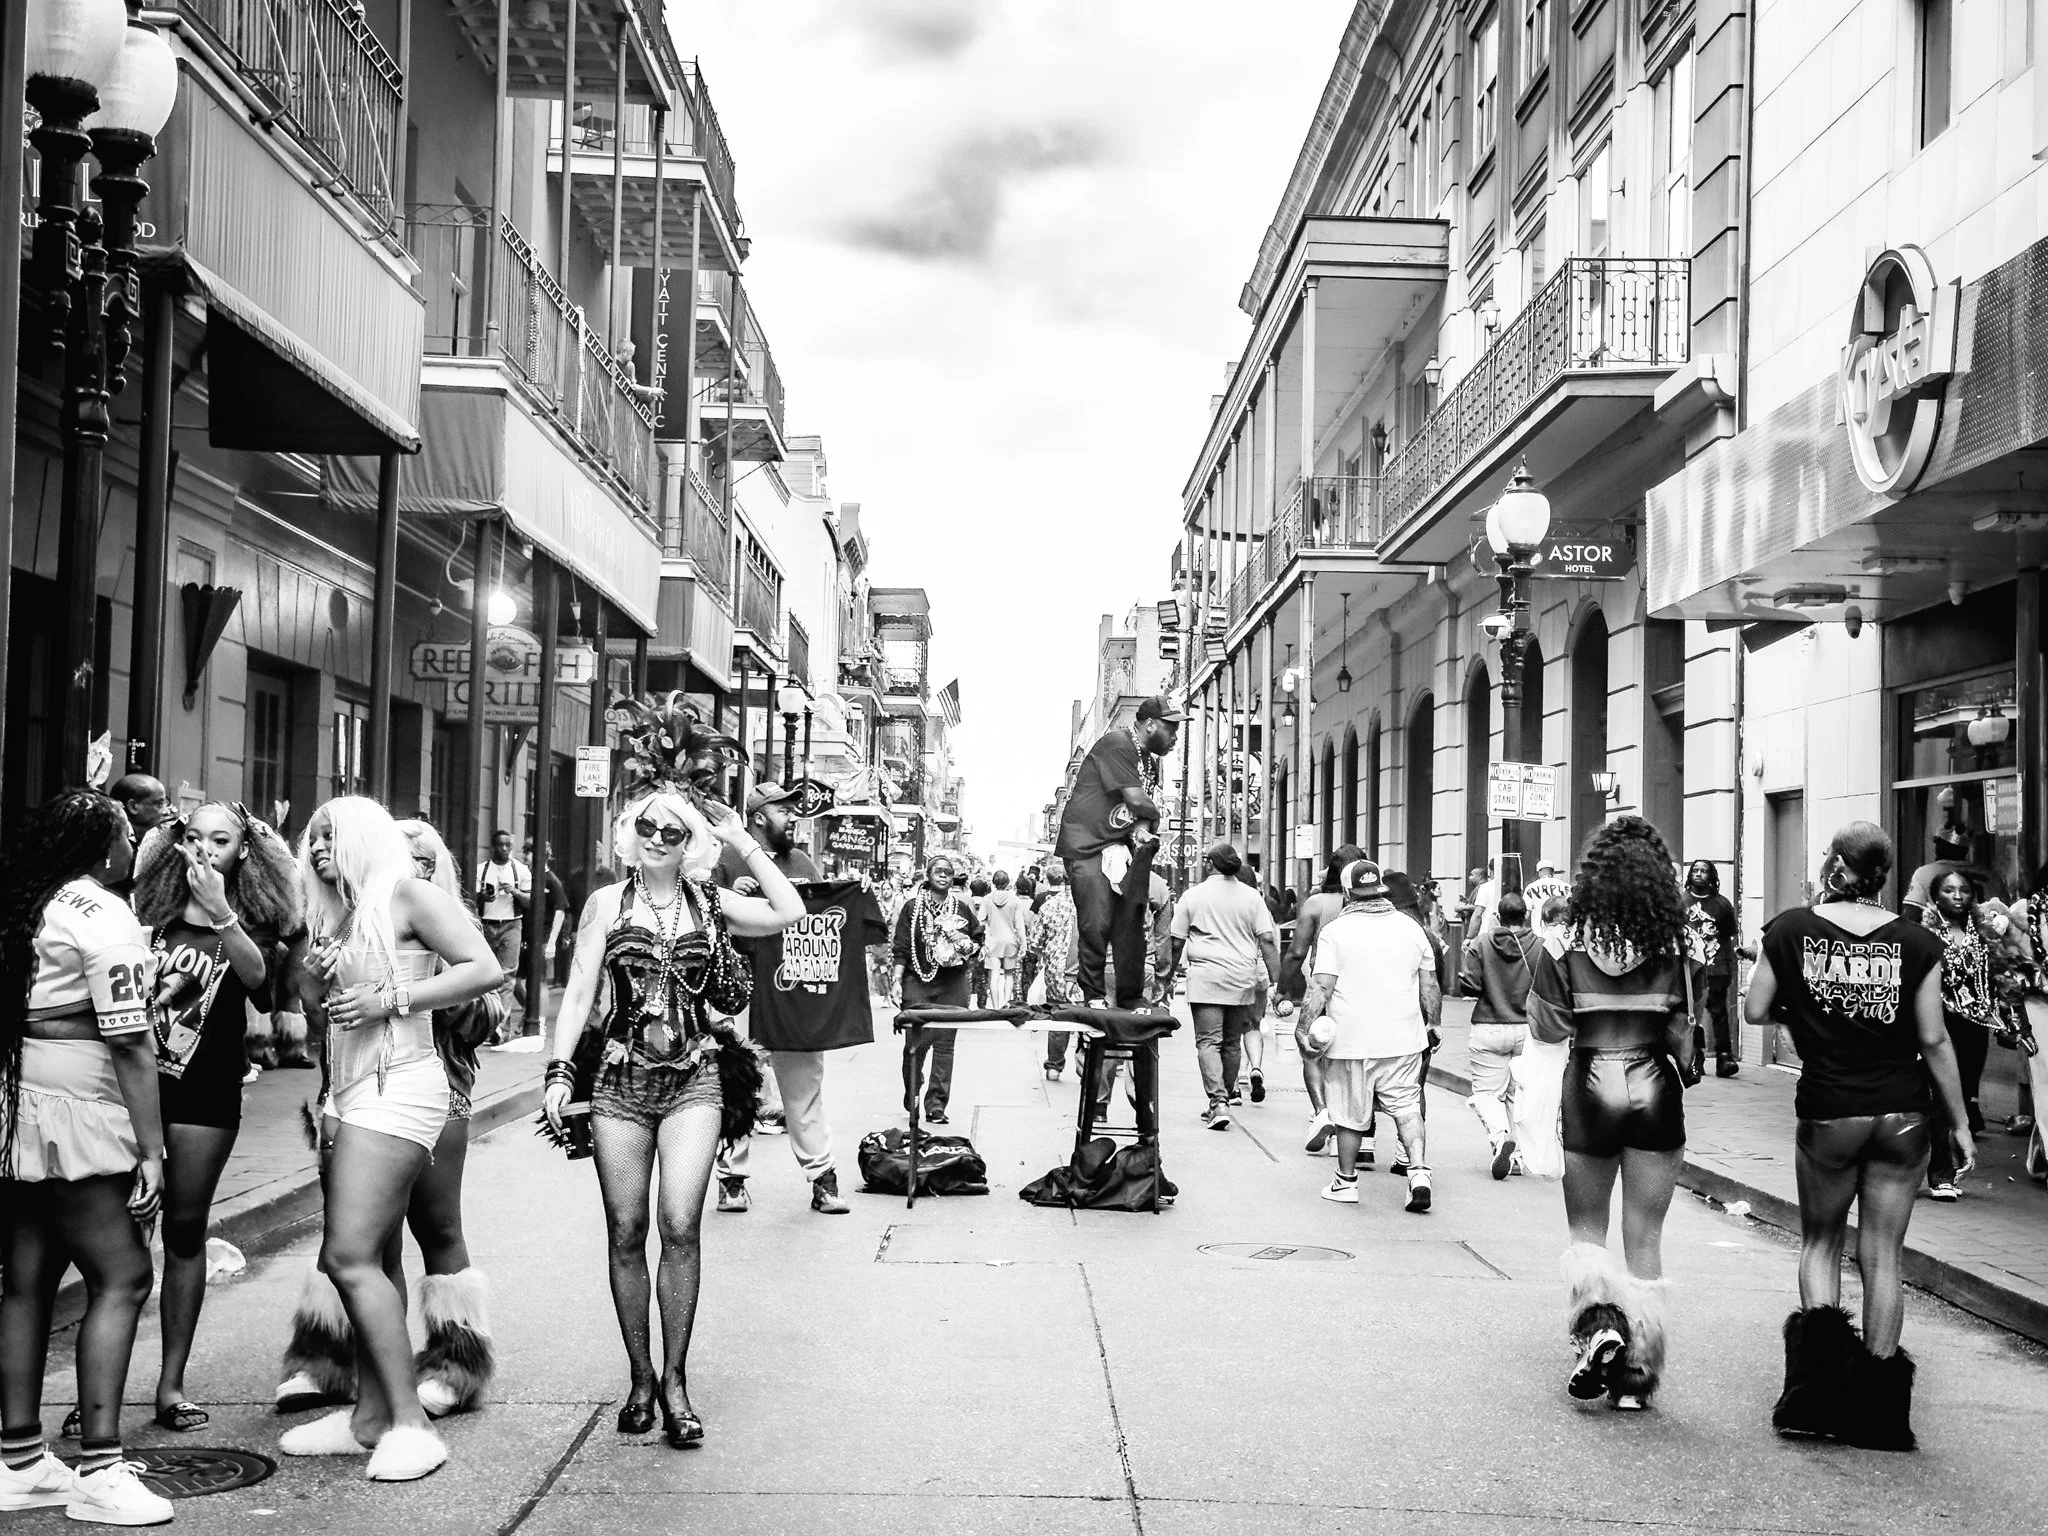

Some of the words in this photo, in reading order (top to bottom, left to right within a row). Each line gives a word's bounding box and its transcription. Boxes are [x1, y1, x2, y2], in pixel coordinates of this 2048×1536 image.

[1548, 545, 1613, 562] ASTOR
[1565, 564, 1596, 573] HOTEL
[523, 652, 581, 679] FH
[583, 773, 602, 782] LANE
[1498, 783, 1512, 792] CAB
[1525, 785, 1553, 793] FREIGHT
[807, 789, 833, 803] Rock
[1493, 795, 1517, 804] STAND
[1530, 793, 1547, 801] ZONE
[829, 832, 876, 846] MANGO
[784, 937, 839, 958] AROUND
[1803, 952, 1902, 986] MARDI
[1842, 992, 1899, 1024] Gras
[156, 1058, 187, 1073] cean
